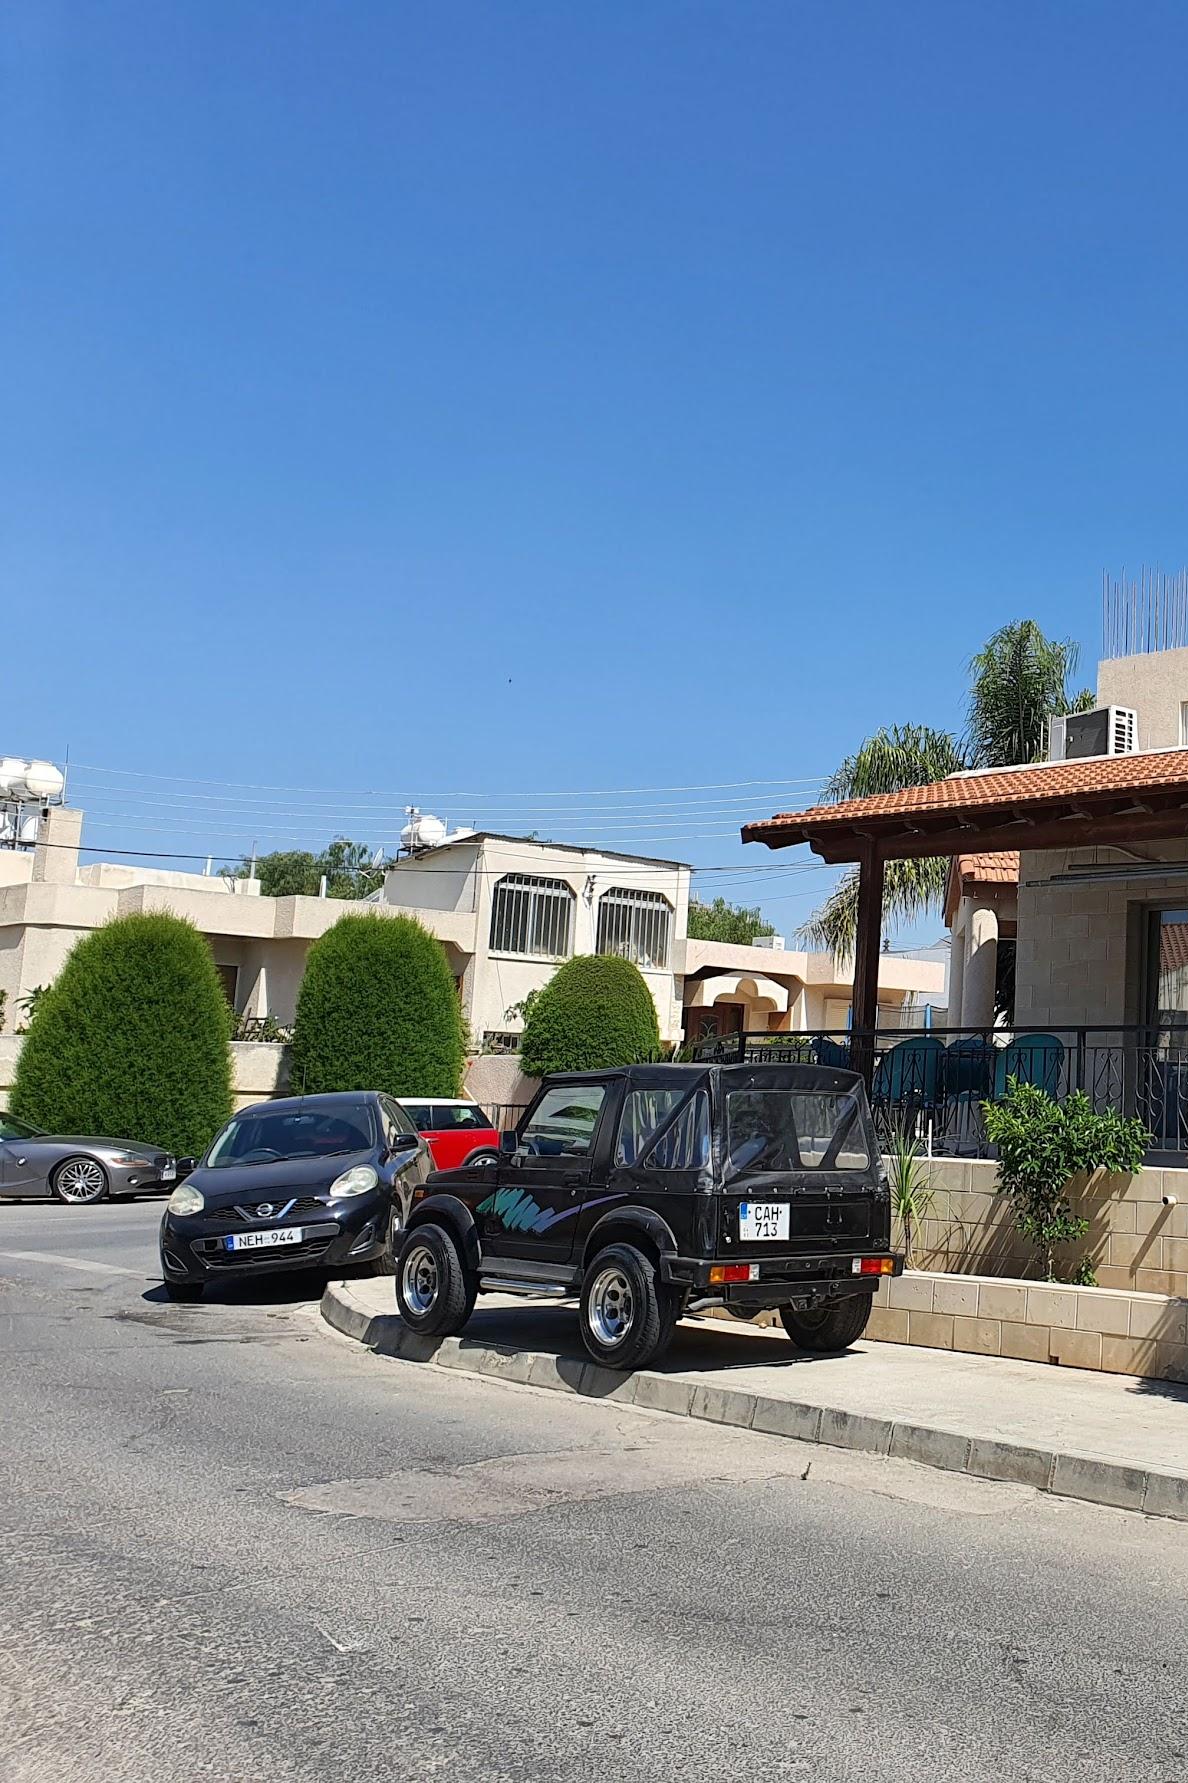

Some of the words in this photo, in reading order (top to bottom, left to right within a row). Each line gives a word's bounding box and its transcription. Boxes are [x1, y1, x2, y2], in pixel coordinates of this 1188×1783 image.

[755, 1206, 779, 1221] CAH
[755, 1222, 778, 1237] 713
[239, 1234, 263, 1247] NEH
[271, 1230, 294, 1243] 944
